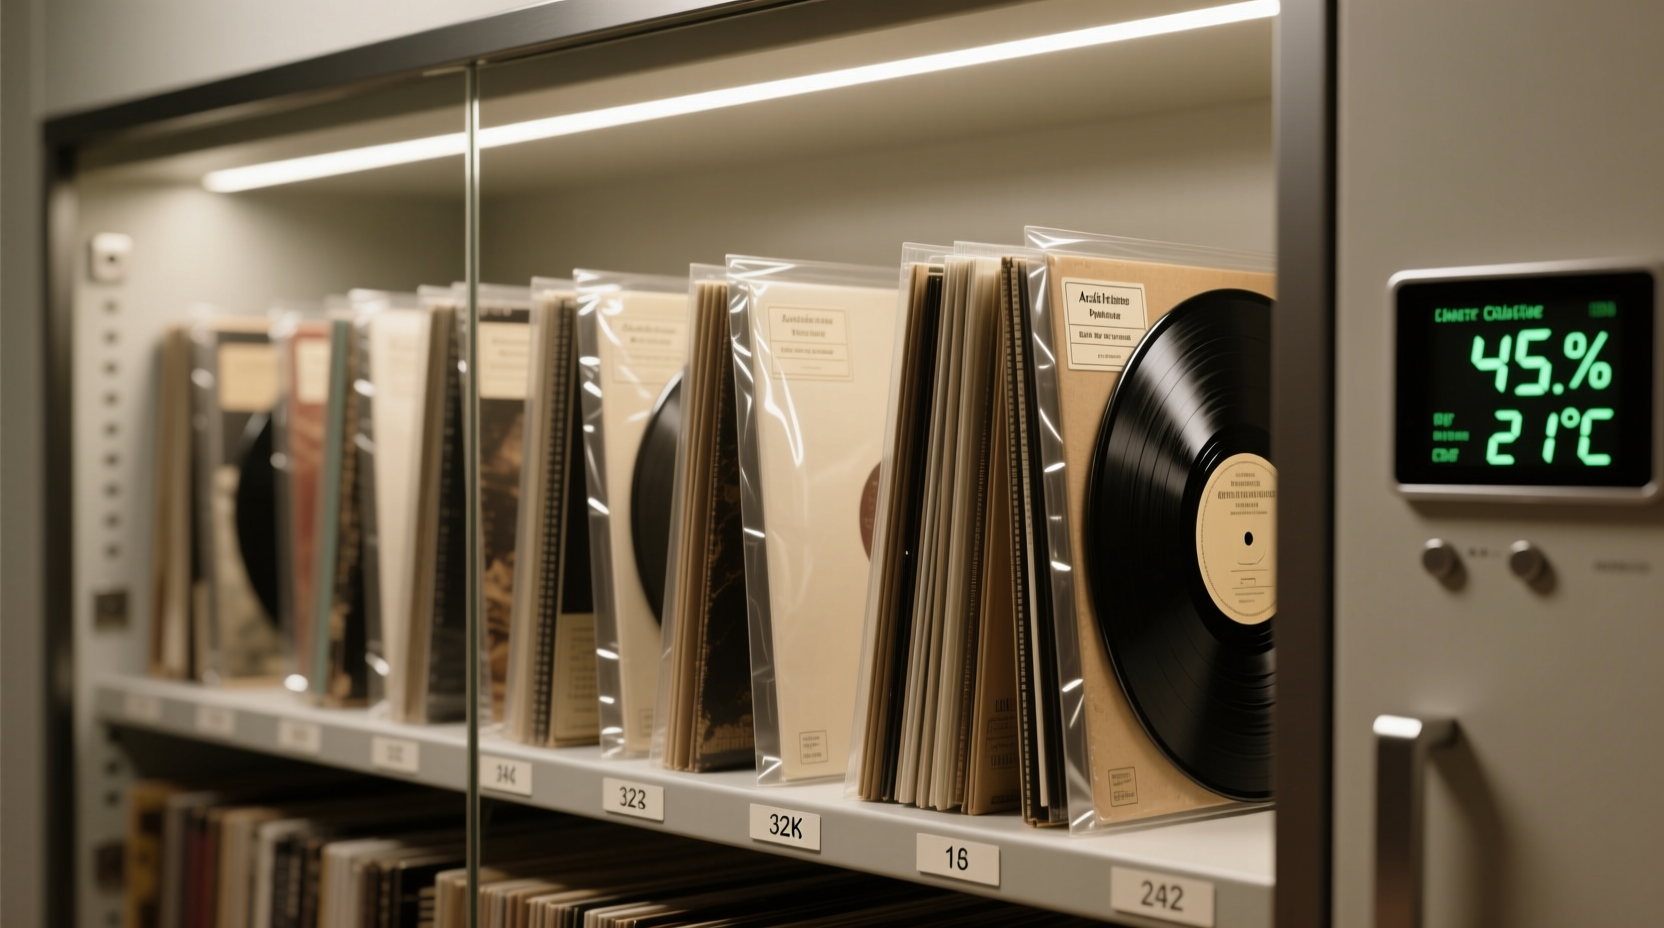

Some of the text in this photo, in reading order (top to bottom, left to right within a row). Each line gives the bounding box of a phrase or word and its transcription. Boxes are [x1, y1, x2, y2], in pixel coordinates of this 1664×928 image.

[1486, 406, 1614, 466] 21°C
[769, 813, 803, 840] 32K
[945, 845, 969, 871] 16
[1141, 880, 1184, 912] 242
